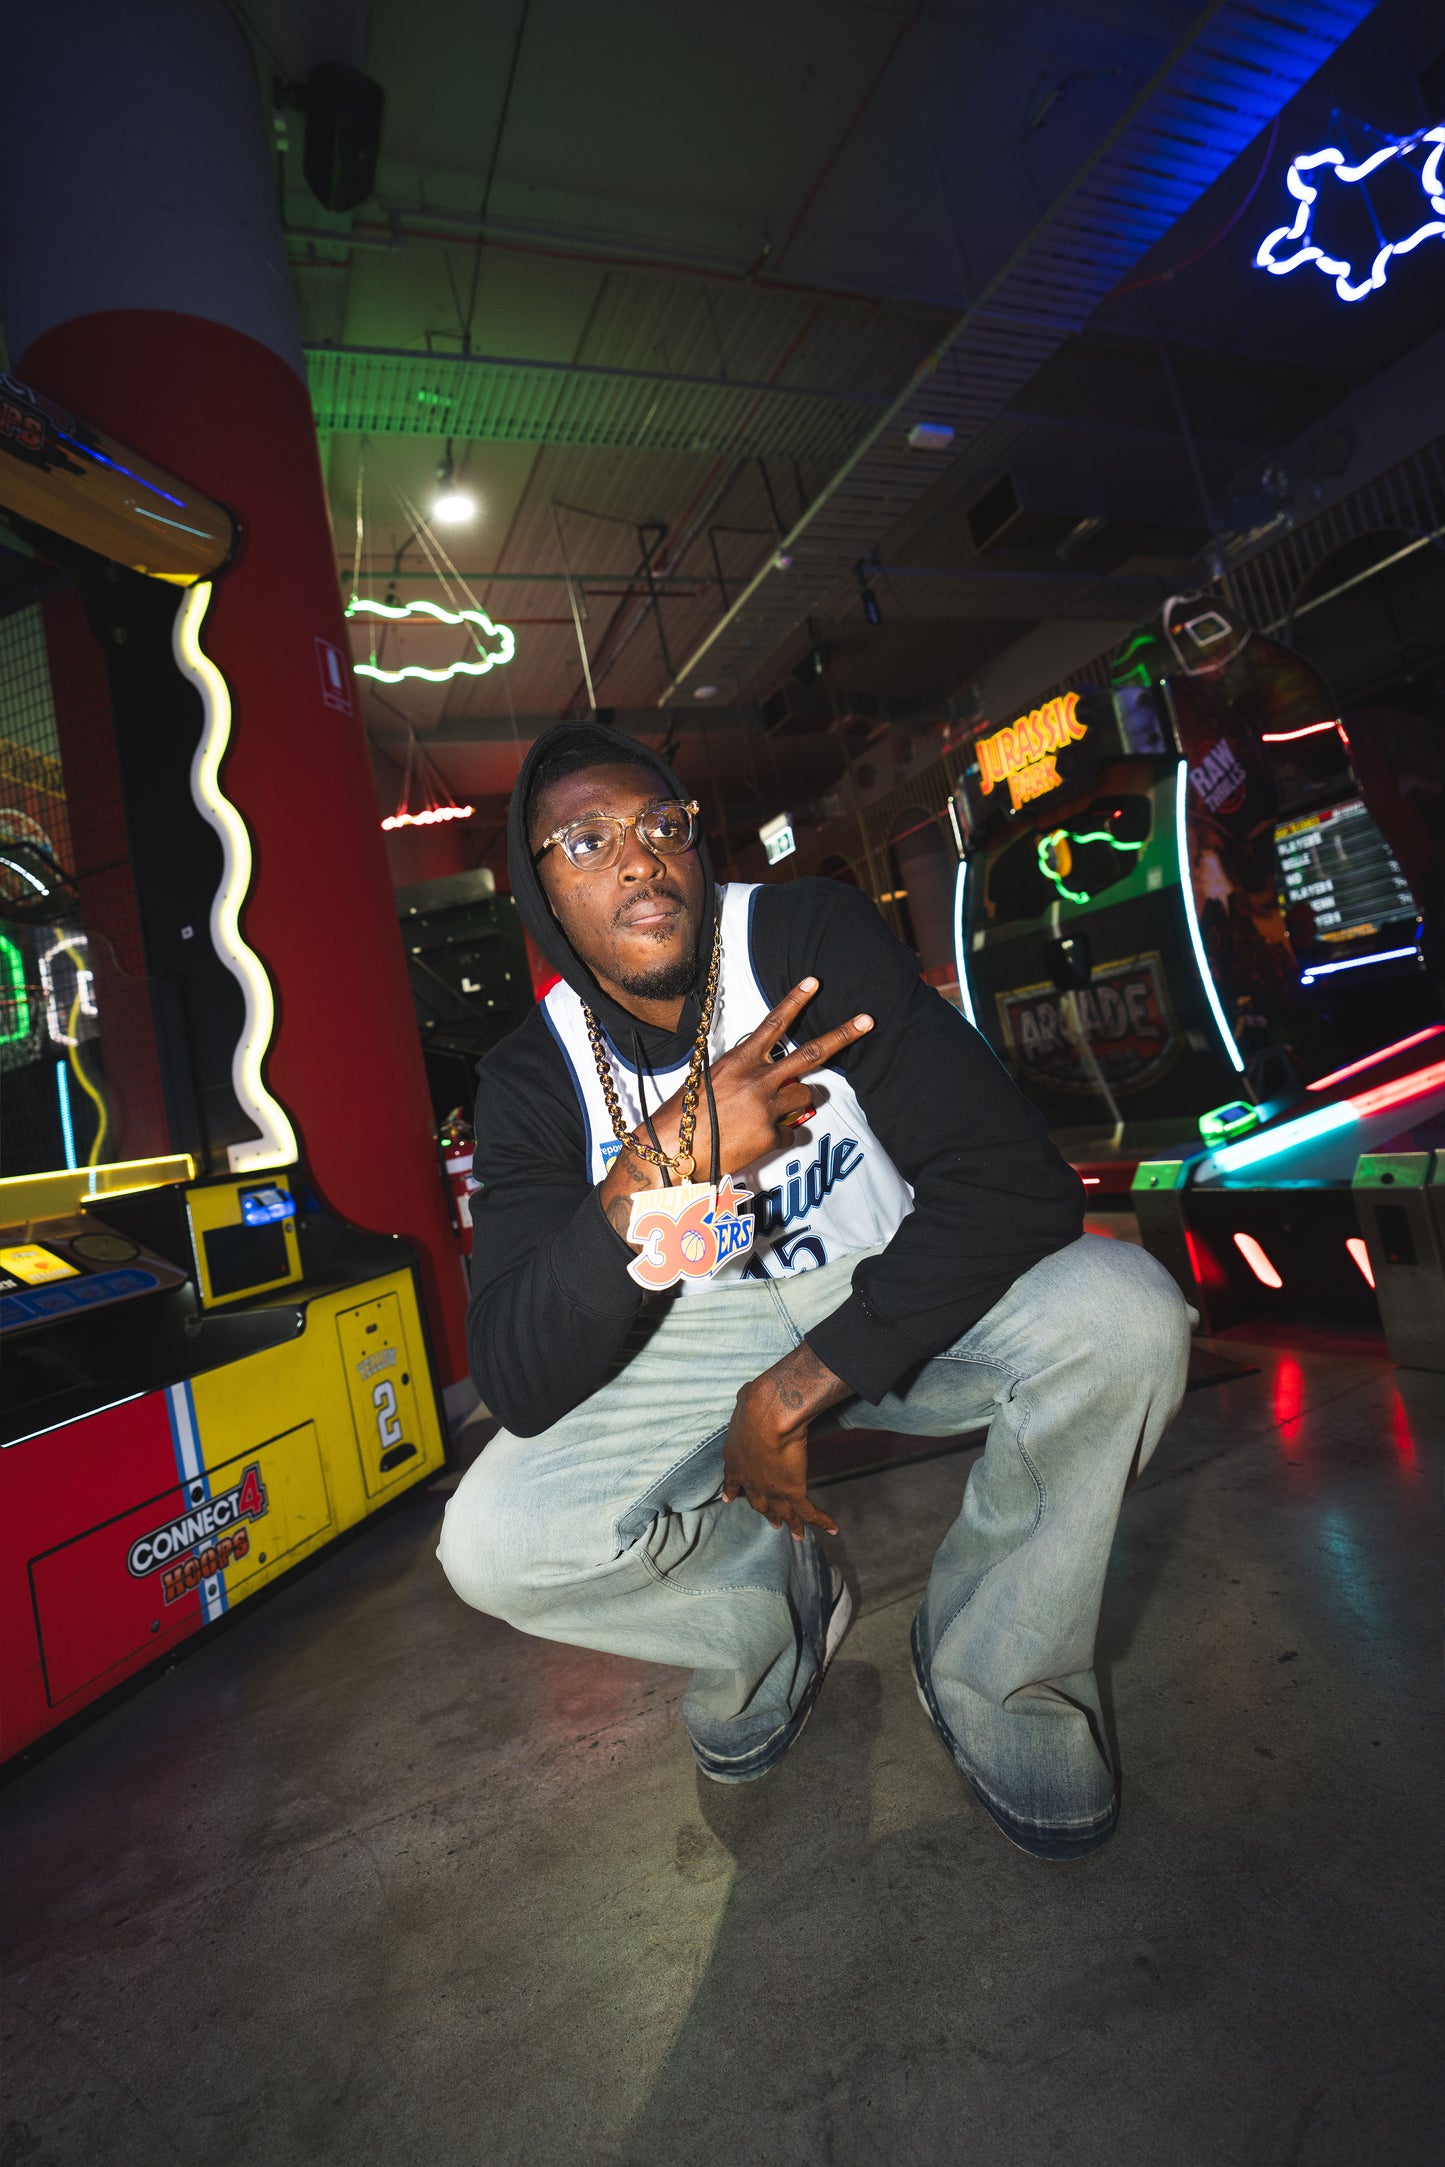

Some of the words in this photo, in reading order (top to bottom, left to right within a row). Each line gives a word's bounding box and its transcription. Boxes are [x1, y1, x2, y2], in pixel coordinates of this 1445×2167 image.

[976, 692, 1088, 795] JURASSIC
[1190, 738, 1236, 798] RAW
[1008, 756, 1063, 810] PARK
[373, 1379, 402, 1450] 2
[132, 1492, 240, 1571] CONNECT
[239, 1469, 263, 1515] 4
[161, 1526, 250, 1606] HOOPS
